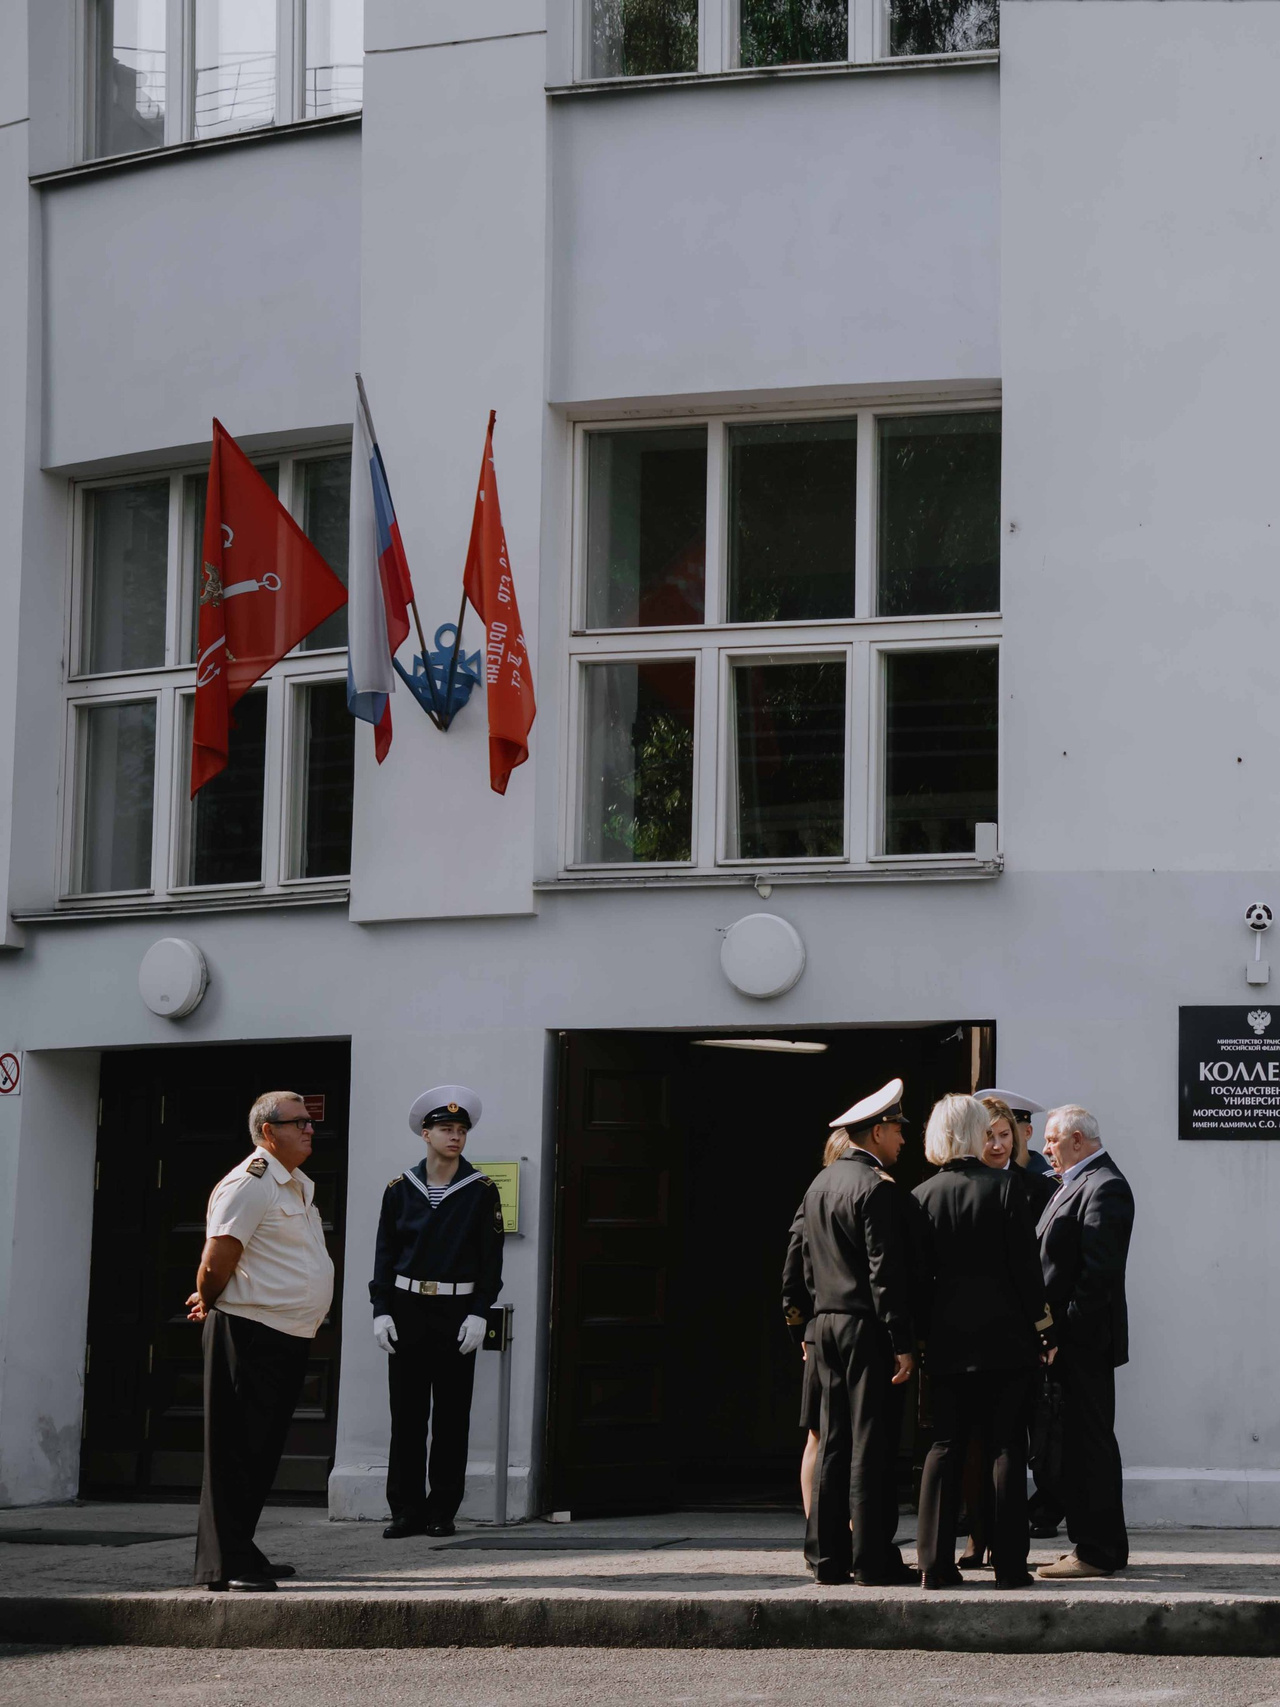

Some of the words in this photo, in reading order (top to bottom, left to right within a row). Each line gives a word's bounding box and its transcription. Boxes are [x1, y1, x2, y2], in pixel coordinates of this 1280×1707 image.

[1192, 1109, 1242, 1117] МОРСКОГО
[1244, 1109, 1252, 1117] И
[1258, 1120, 1277, 1129] С.О.
